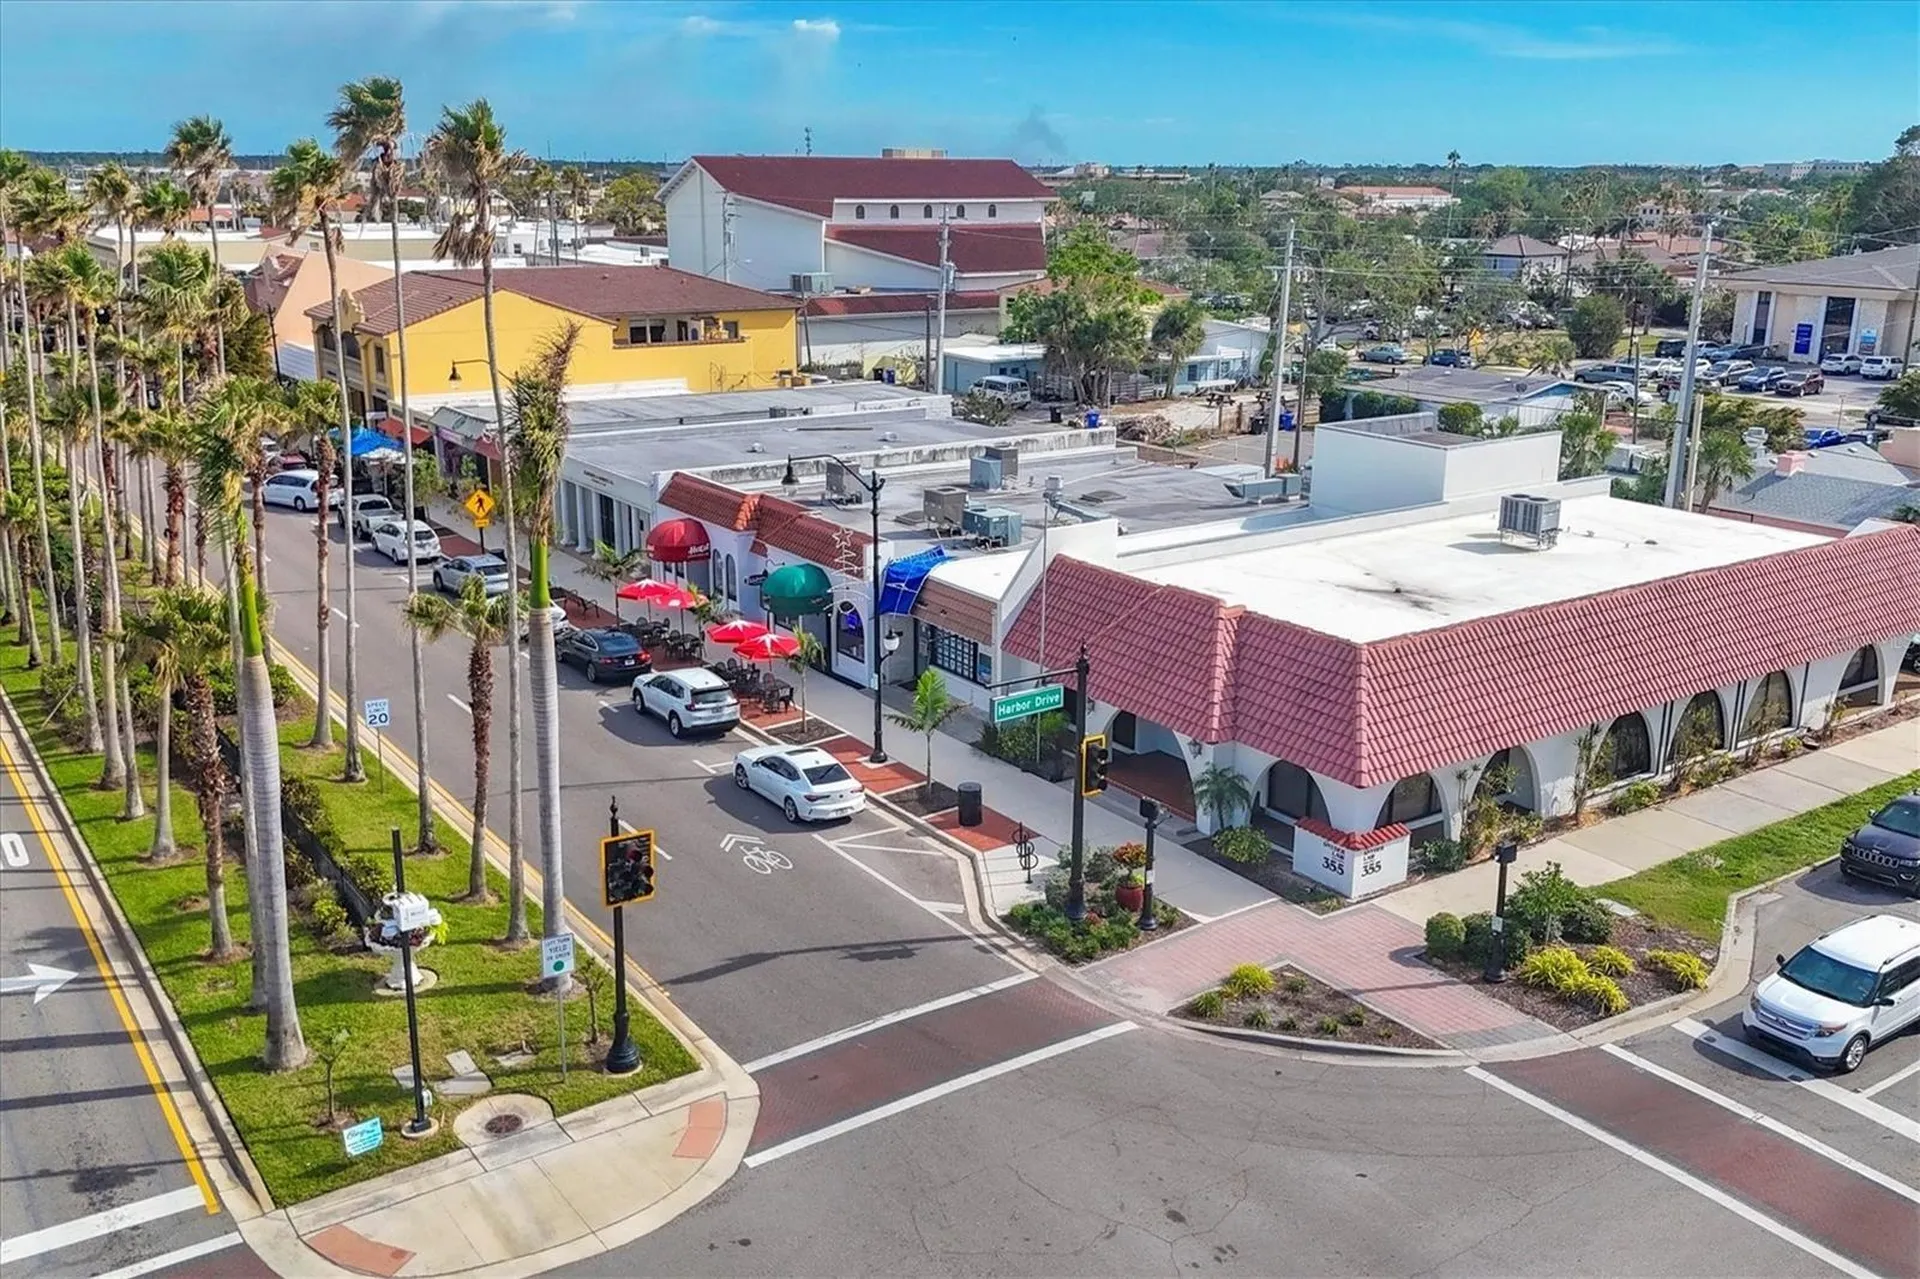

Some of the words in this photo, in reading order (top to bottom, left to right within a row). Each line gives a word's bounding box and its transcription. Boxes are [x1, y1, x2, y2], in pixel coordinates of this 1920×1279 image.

[998, 700, 1031, 716] Harbor
[1035, 693, 1060, 707] Drive
[368, 712, 389, 725] 20
[1322, 856, 1345, 876] 355
[1361, 861, 1382, 877] 355
